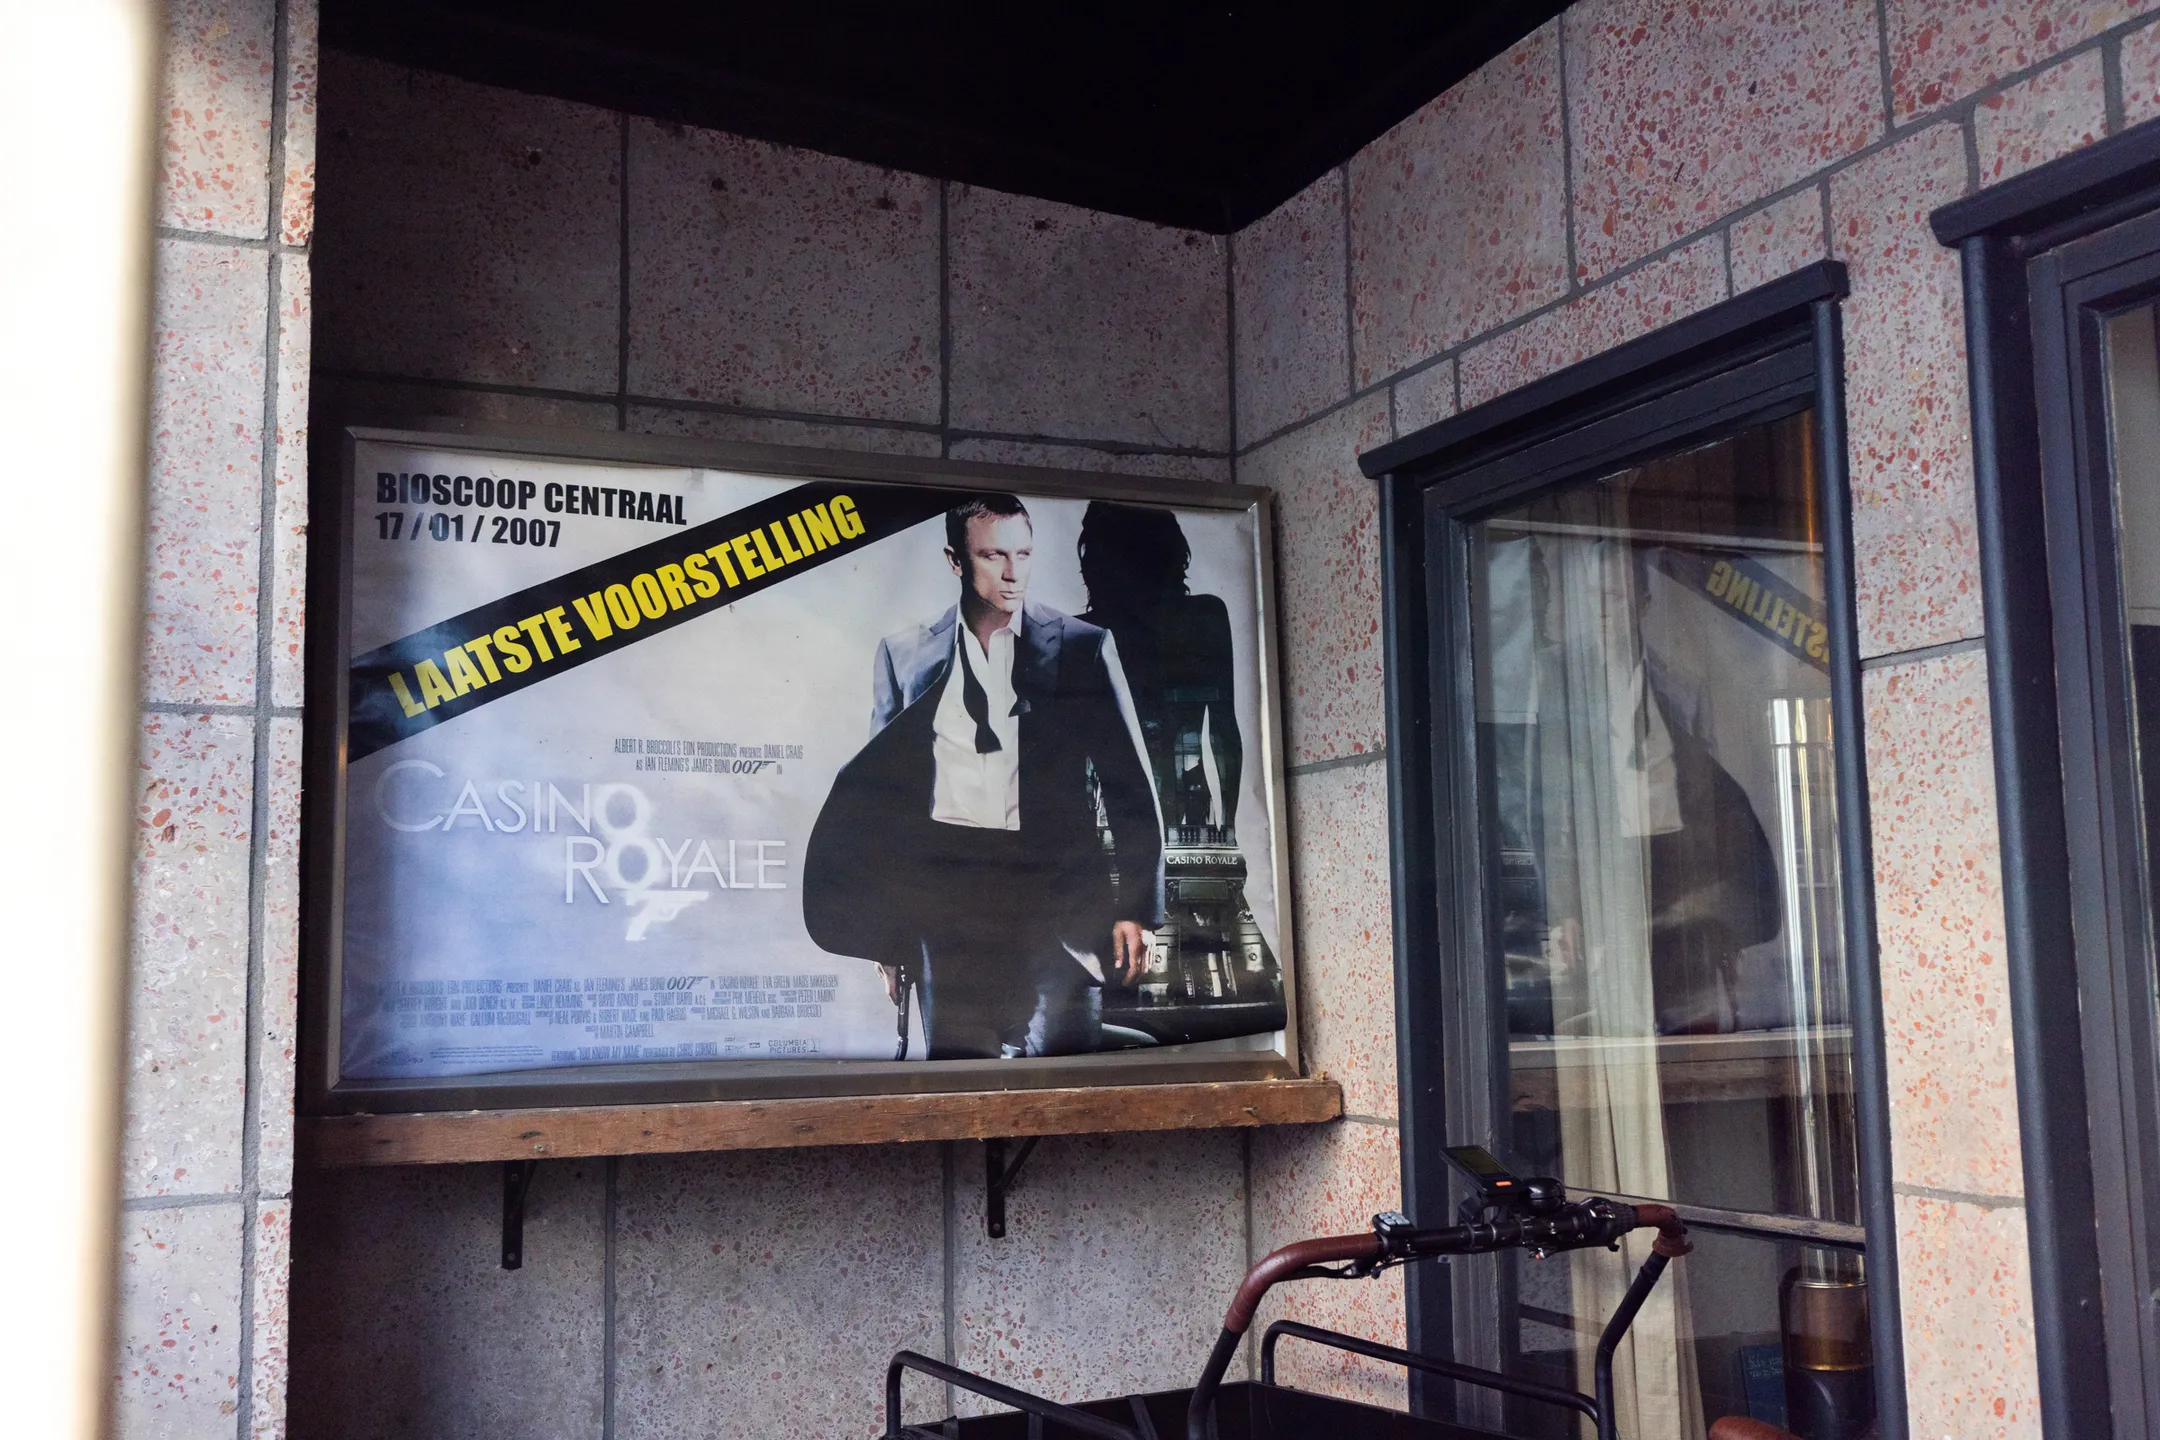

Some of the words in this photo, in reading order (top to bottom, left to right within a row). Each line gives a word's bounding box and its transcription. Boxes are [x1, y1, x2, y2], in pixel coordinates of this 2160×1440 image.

[376, 472, 535, 511] BIOSCOOP
[544, 482, 687, 526] CENTRAAL
[375, 514, 401, 540] 17
[428, 514, 464, 542] 01
[492, 516, 561, 548] 2007
[387, 605, 579, 719] LAATSTE
[572, 494, 865, 641] VOORSTELLING
[615, 738, 637, 754] ALBERT
[638, 739, 645, 754] R.
[646, 740, 681, 756] BROCCOLI'S
[683, 741, 695, 756] EON
[697, 742, 738, 758] PRODUCTIONS
[740, 746, 762, 758] PRESENTS
[764, 744, 785, 759] DANIEL
[786, 745, 803, 760] CRAIG
[636, 760, 643, 771] AS
[645, 757, 656, 772] IAN
[658, 757, 690, 772] FLEMING'S
[692, 758, 713, 773] JAMES
[714, 759, 731, 774] BOND
[732, 759, 772, 775] 007
[375, 759, 652, 835] CASINO
[1166, 855, 1203, 865] CASINO
[1205, 855, 1238, 865] ROYALE
[564, 835, 787, 904] ROYALE
[533, 978, 552, 993] DANIEL
[555, 978, 573, 993] CRAIG
[628, 977, 648, 991] JAMES
[667, 976, 706, 990] 007
[653, 992, 674, 1006] STUART
[600, 1024, 622, 1039] MARTIN
[624, 1023, 654, 1038] CAMPBELL
[768, 1039, 807, 1047] COLUMBIA
[769, 1046, 807, 1054] PICTURES
